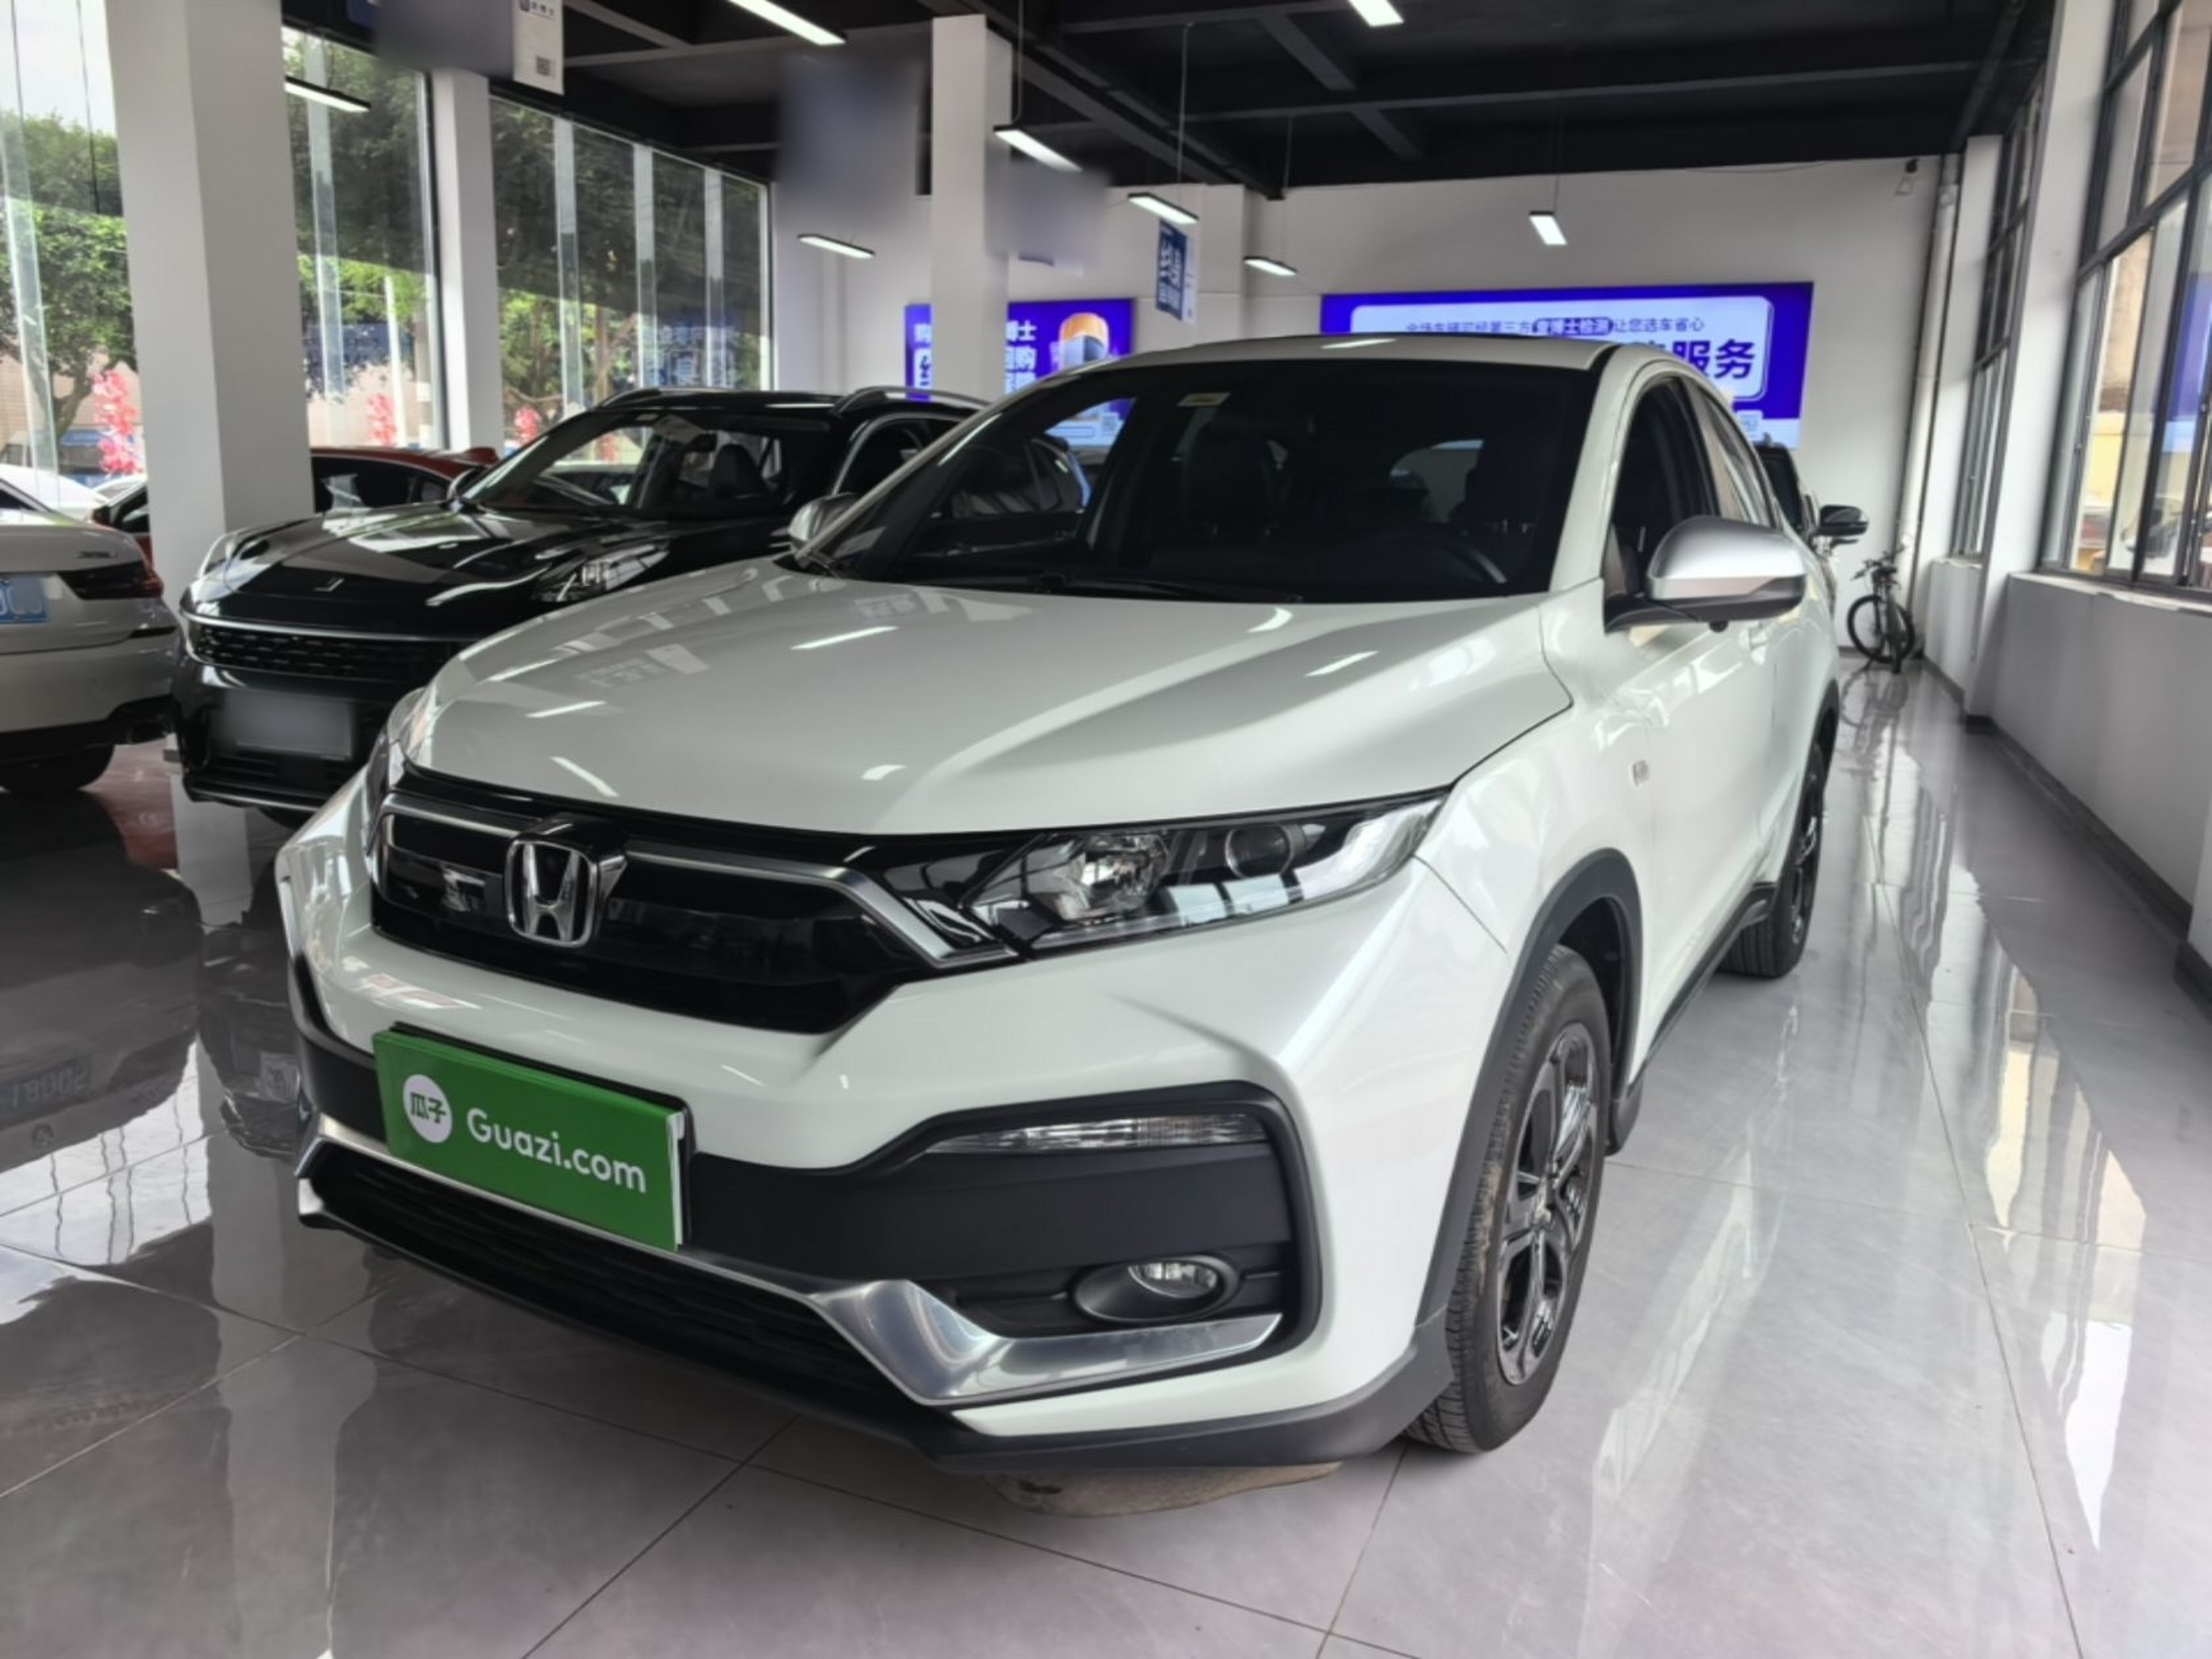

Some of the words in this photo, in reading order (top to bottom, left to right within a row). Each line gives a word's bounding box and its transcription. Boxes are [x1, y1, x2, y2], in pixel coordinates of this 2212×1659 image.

[1649, 339, 1755, 379] 服务
[410, 1092, 446, 1124] 瓜子
[467, 1108, 647, 1194] Guazi.com
